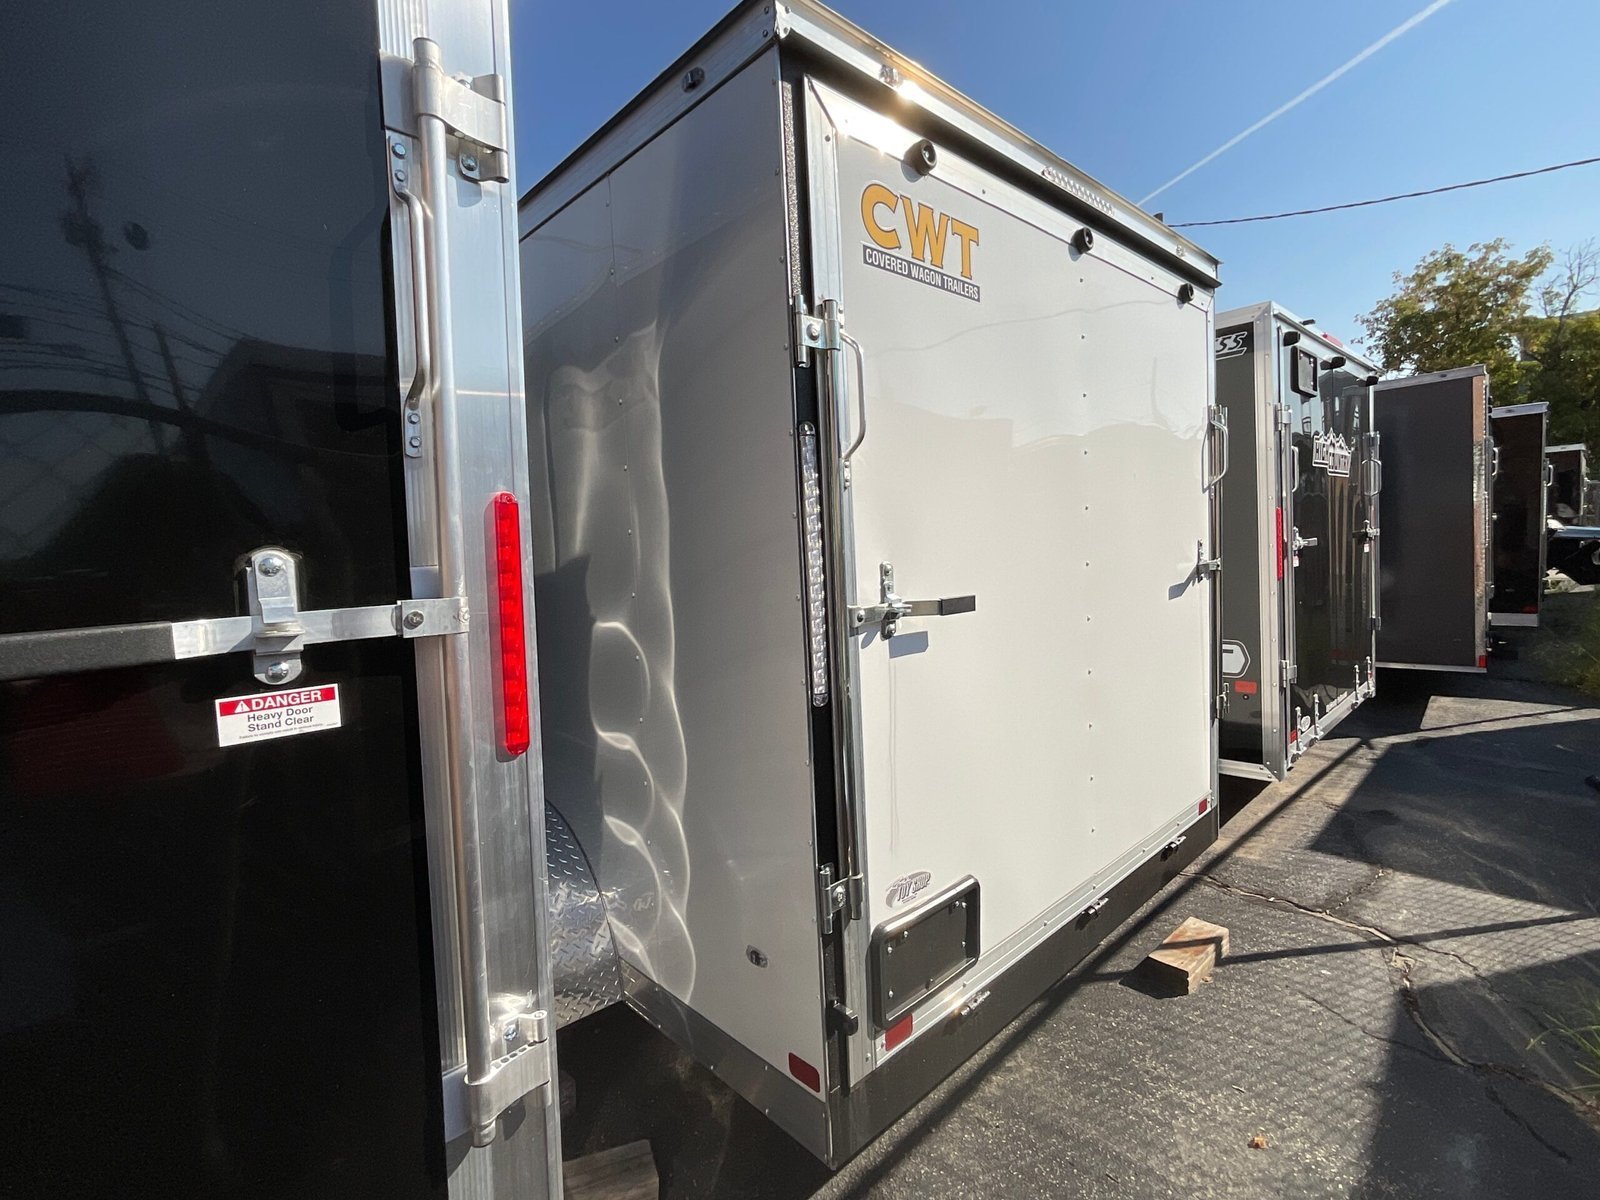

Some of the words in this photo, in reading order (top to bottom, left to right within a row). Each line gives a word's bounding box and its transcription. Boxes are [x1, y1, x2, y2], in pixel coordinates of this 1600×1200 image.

[861, 183, 979, 280] CWT
[865, 248, 908, 275] COVERED
[910, 264, 942, 287] WAGON
[943, 276, 979, 300] TRAILERS
[251, 690, 322, 710] DANGER
[247, 710, 283, 723] Heavy
[286, 706, 314, 717] Door
[248, 720, 282, 733] Stand
[285, 715, 314, 727] Clear
